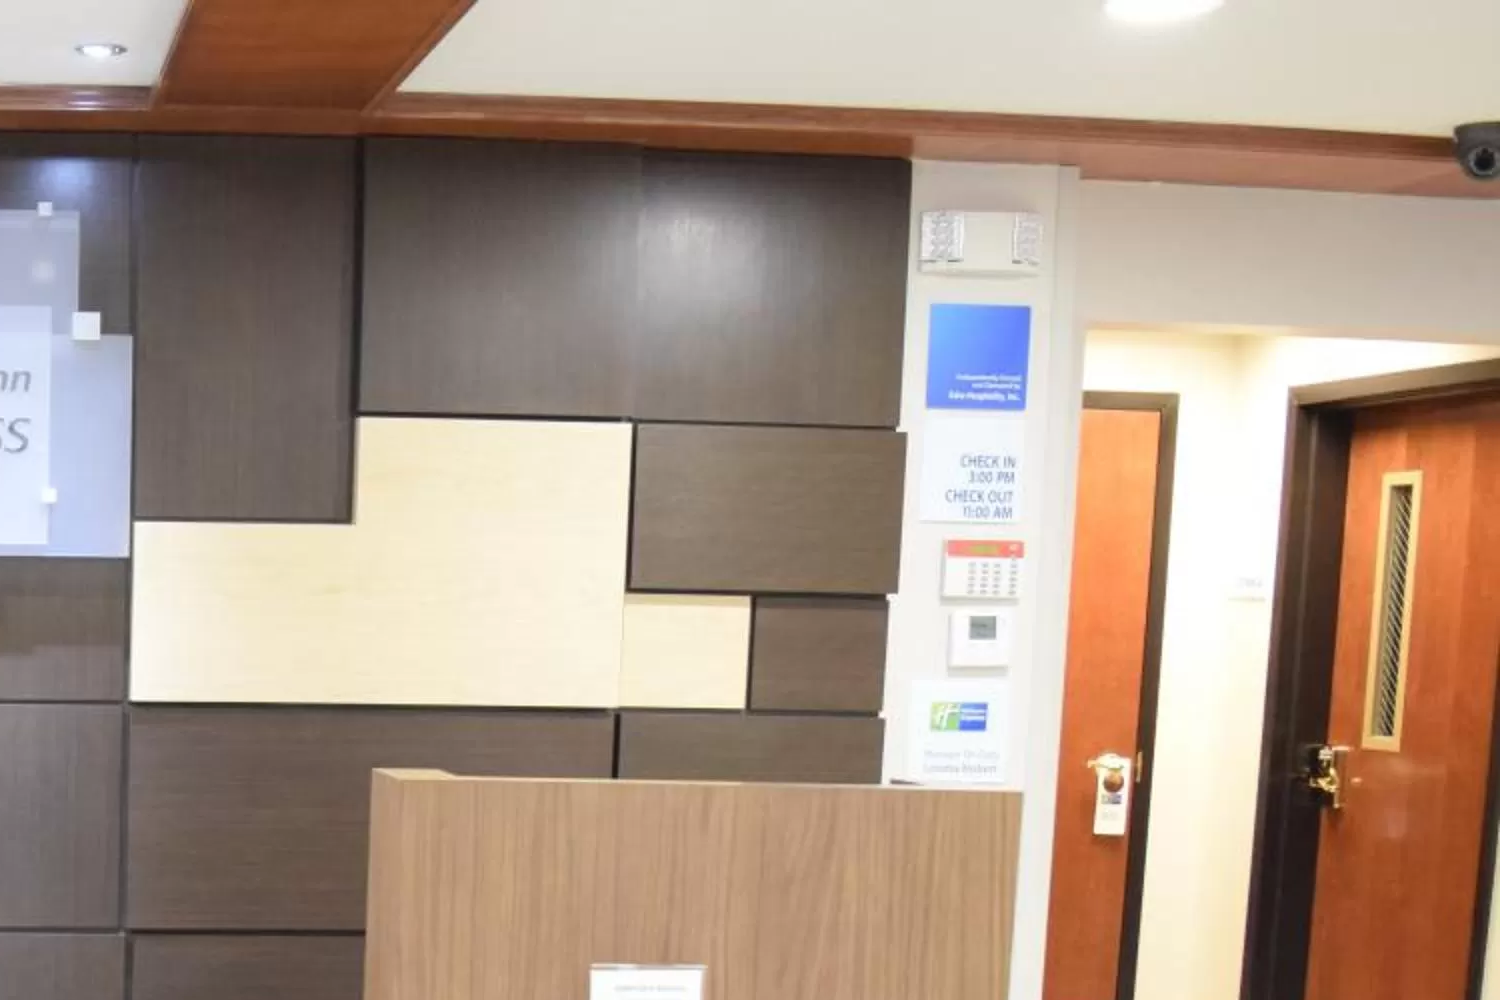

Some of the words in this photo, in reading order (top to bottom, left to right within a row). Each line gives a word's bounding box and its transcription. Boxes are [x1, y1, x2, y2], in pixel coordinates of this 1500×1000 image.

[960, 455, 1000, 469] CHECK
[1003, 455, 1017, 469] IN
[968, 470, 993, 484] 3:00
[996, 471, 1015, 485] PM
[944, 488, 985, 504] CHECK
[987, 489, 1014, 504] OUT
[963, 505, 991, 519] 11:00
[993, 505, 1013, 520] AM
